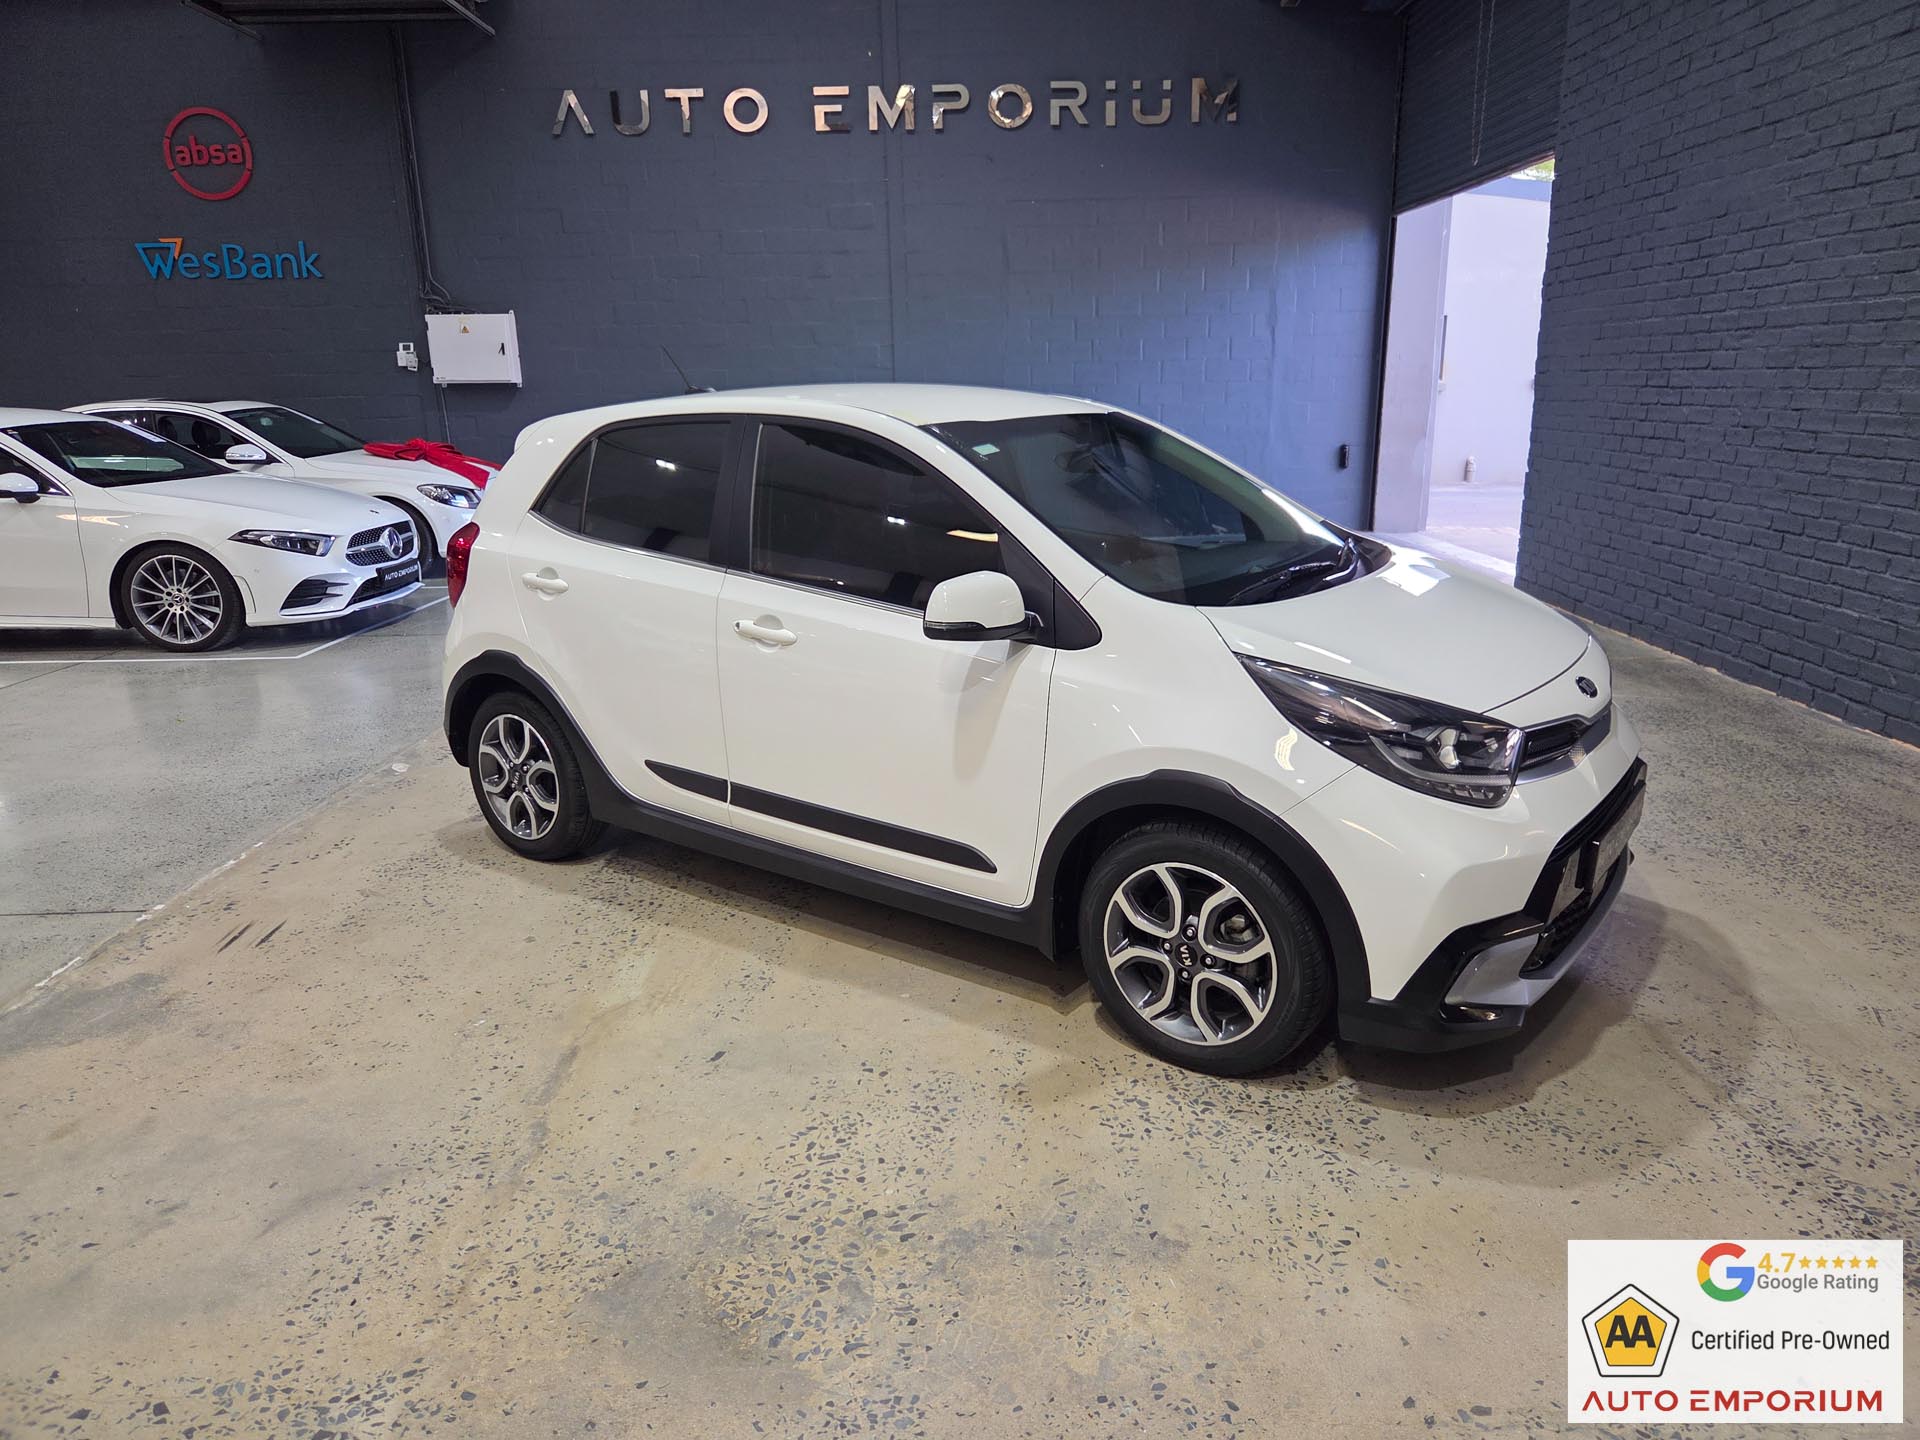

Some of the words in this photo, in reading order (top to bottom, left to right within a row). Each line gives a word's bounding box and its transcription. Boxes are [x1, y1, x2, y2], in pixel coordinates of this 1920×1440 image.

[551, 86, 769, 137] AUTO
[175, 135, 243, 166] absa
[135, 237, 324, 280] WesBank
